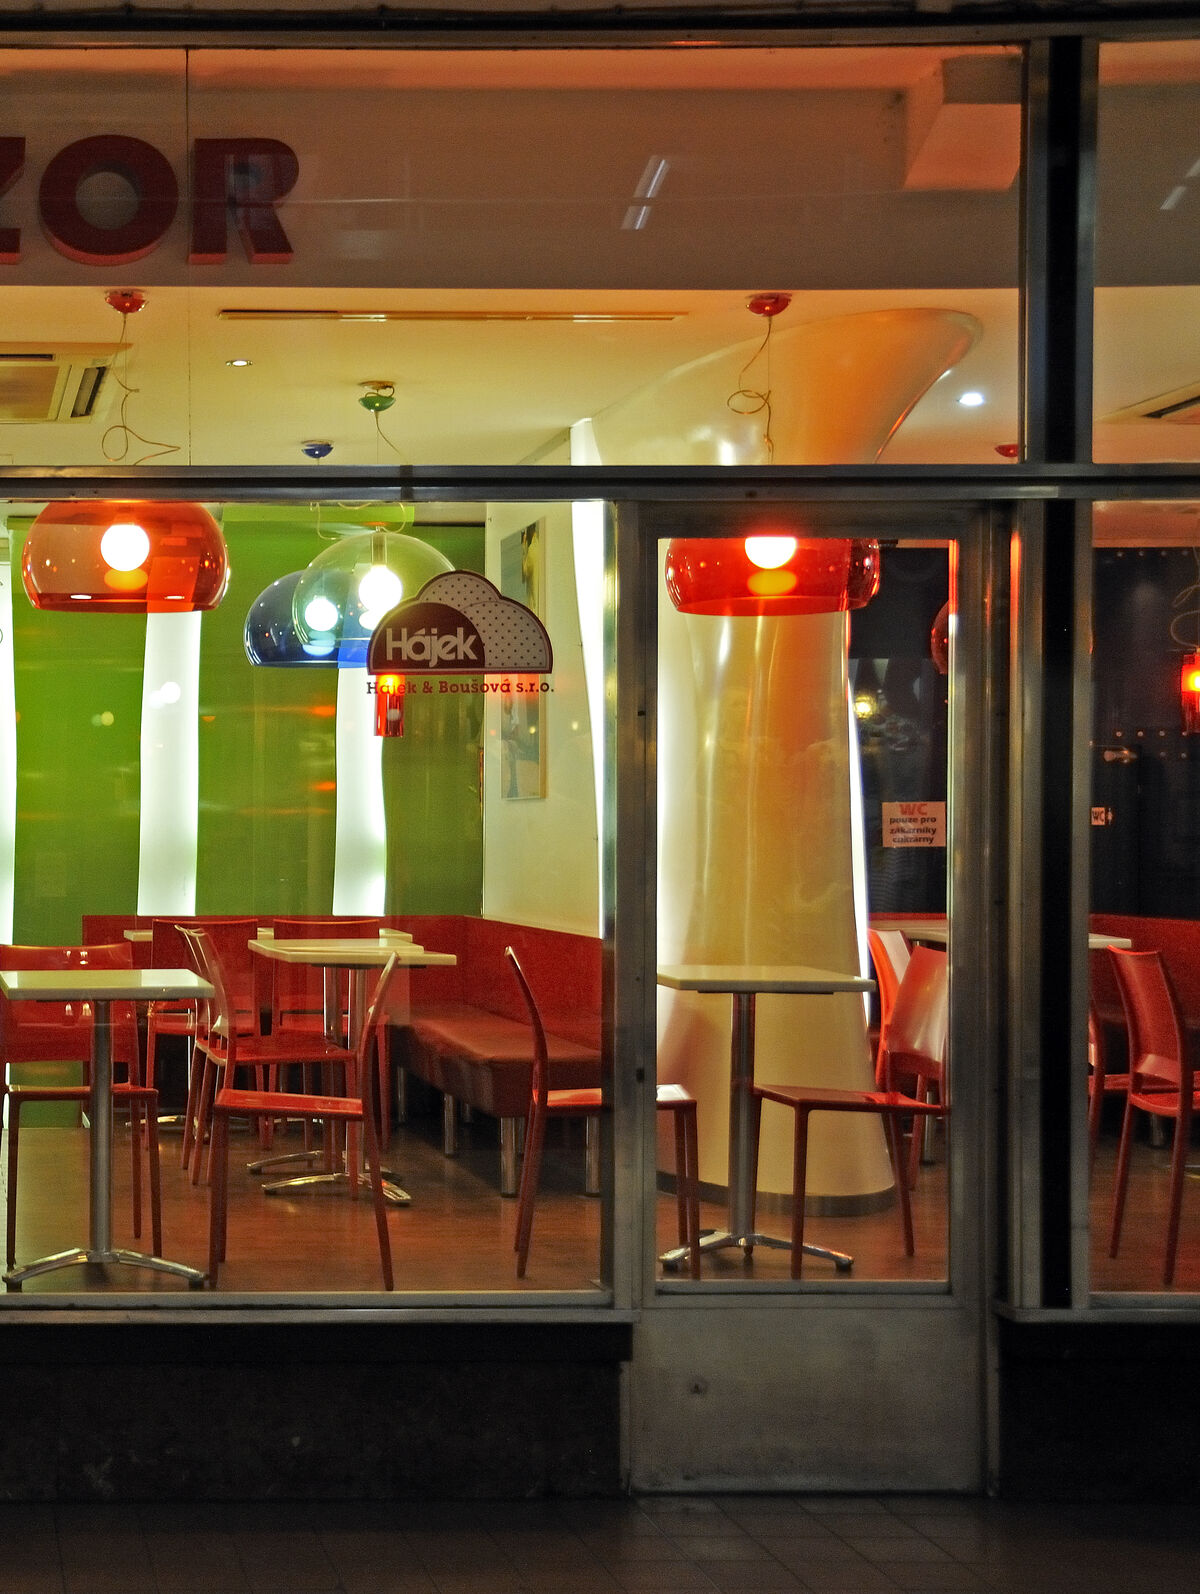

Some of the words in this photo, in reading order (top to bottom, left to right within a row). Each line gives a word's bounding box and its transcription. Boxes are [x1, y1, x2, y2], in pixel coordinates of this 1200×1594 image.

[386, 627, 478, 668] Hájek
[366, 681, 417, 697] Hájek
[422, 681, 434, 694] &
[438, 678, 511, 694] Boušová
[516, 681, 554, 693] s.r.o.
[899, 803, 928, 816] WC
[1092, 810, 1105, 823] WC
